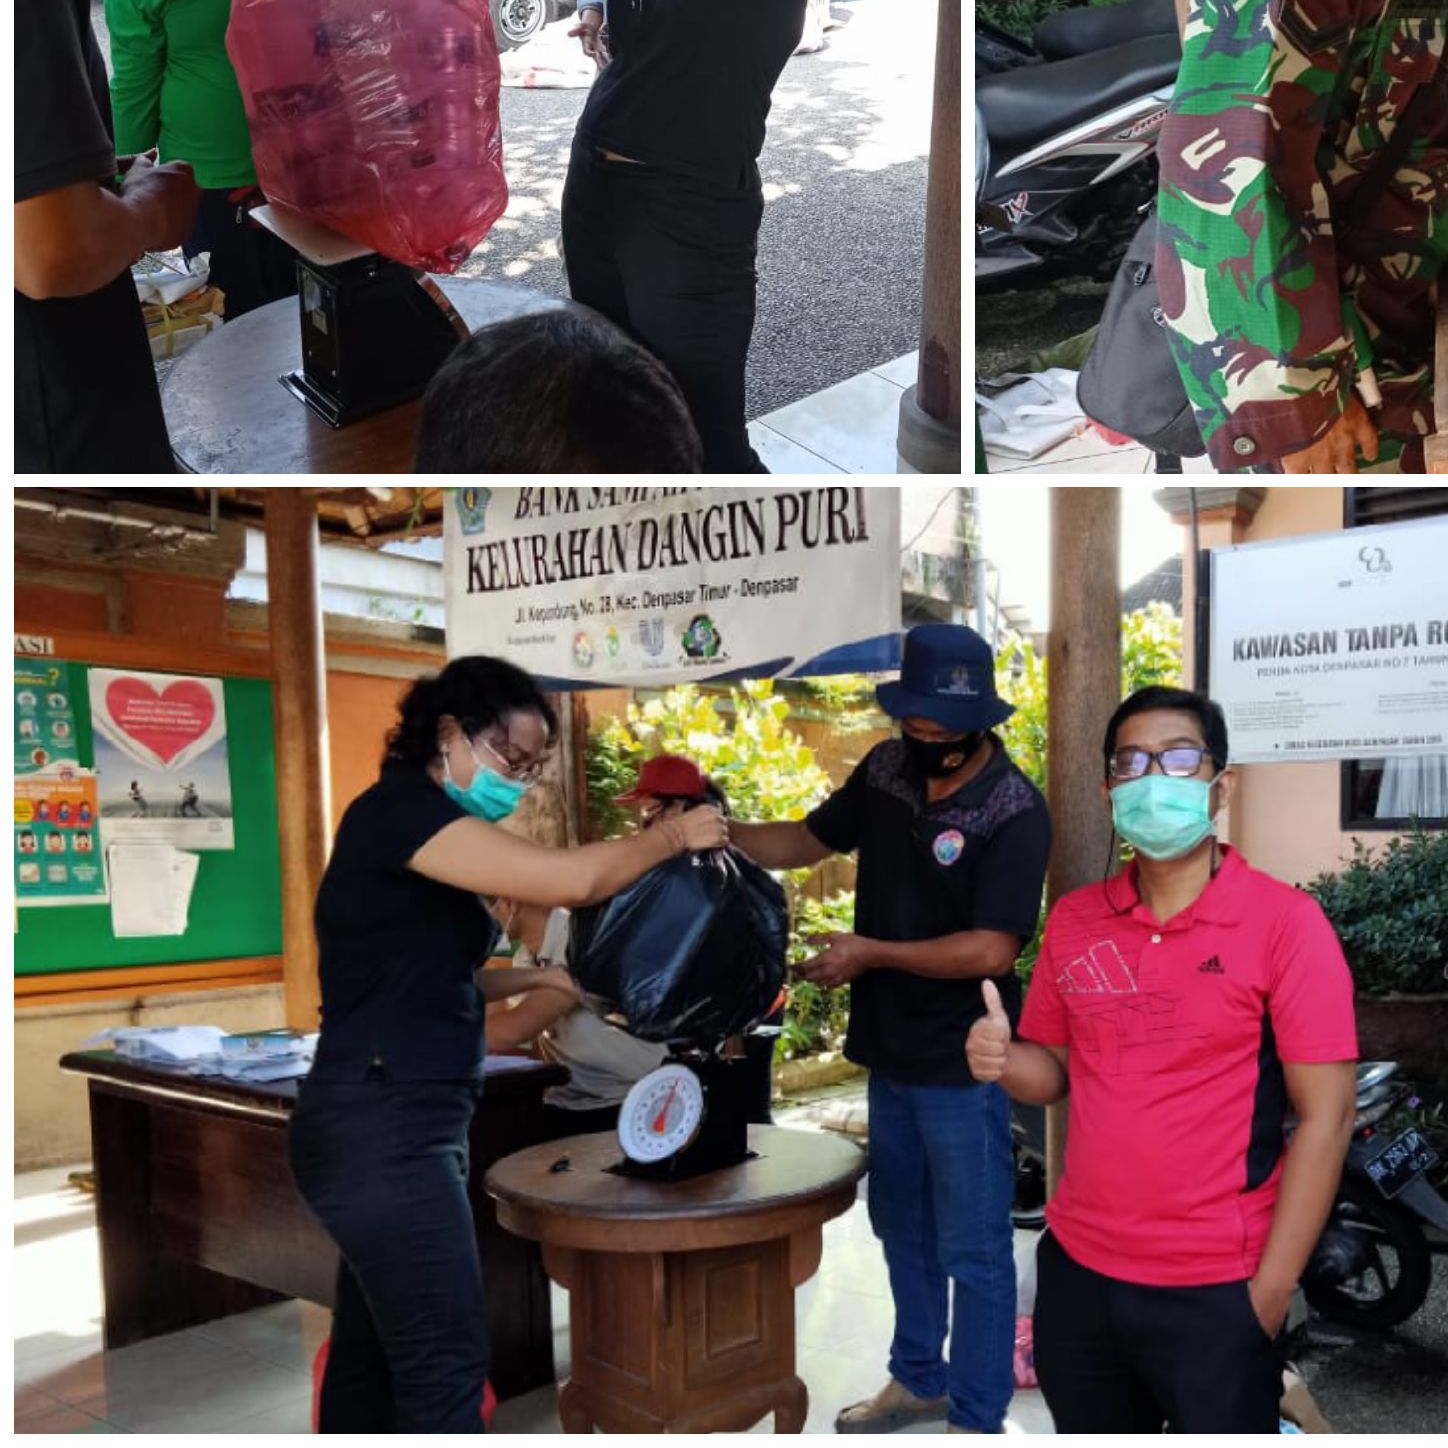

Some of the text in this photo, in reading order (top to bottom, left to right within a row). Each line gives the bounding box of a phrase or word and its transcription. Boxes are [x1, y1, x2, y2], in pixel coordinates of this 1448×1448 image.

[466, 487, 869, 594] KELURAHAN DANGIN PURI
[616, 593, 641, 610] Kec.
[642, 587, 696, 610] Denpasar
[699, 582, 731, 602] Timur
[740, 575, 800, 598] Denpasar
[1233, 629, 1338, 662] KAWASAN
[1344, 622, 1418, 653] TANPA
[1322, 657, 1381, 674] DENPASAR
